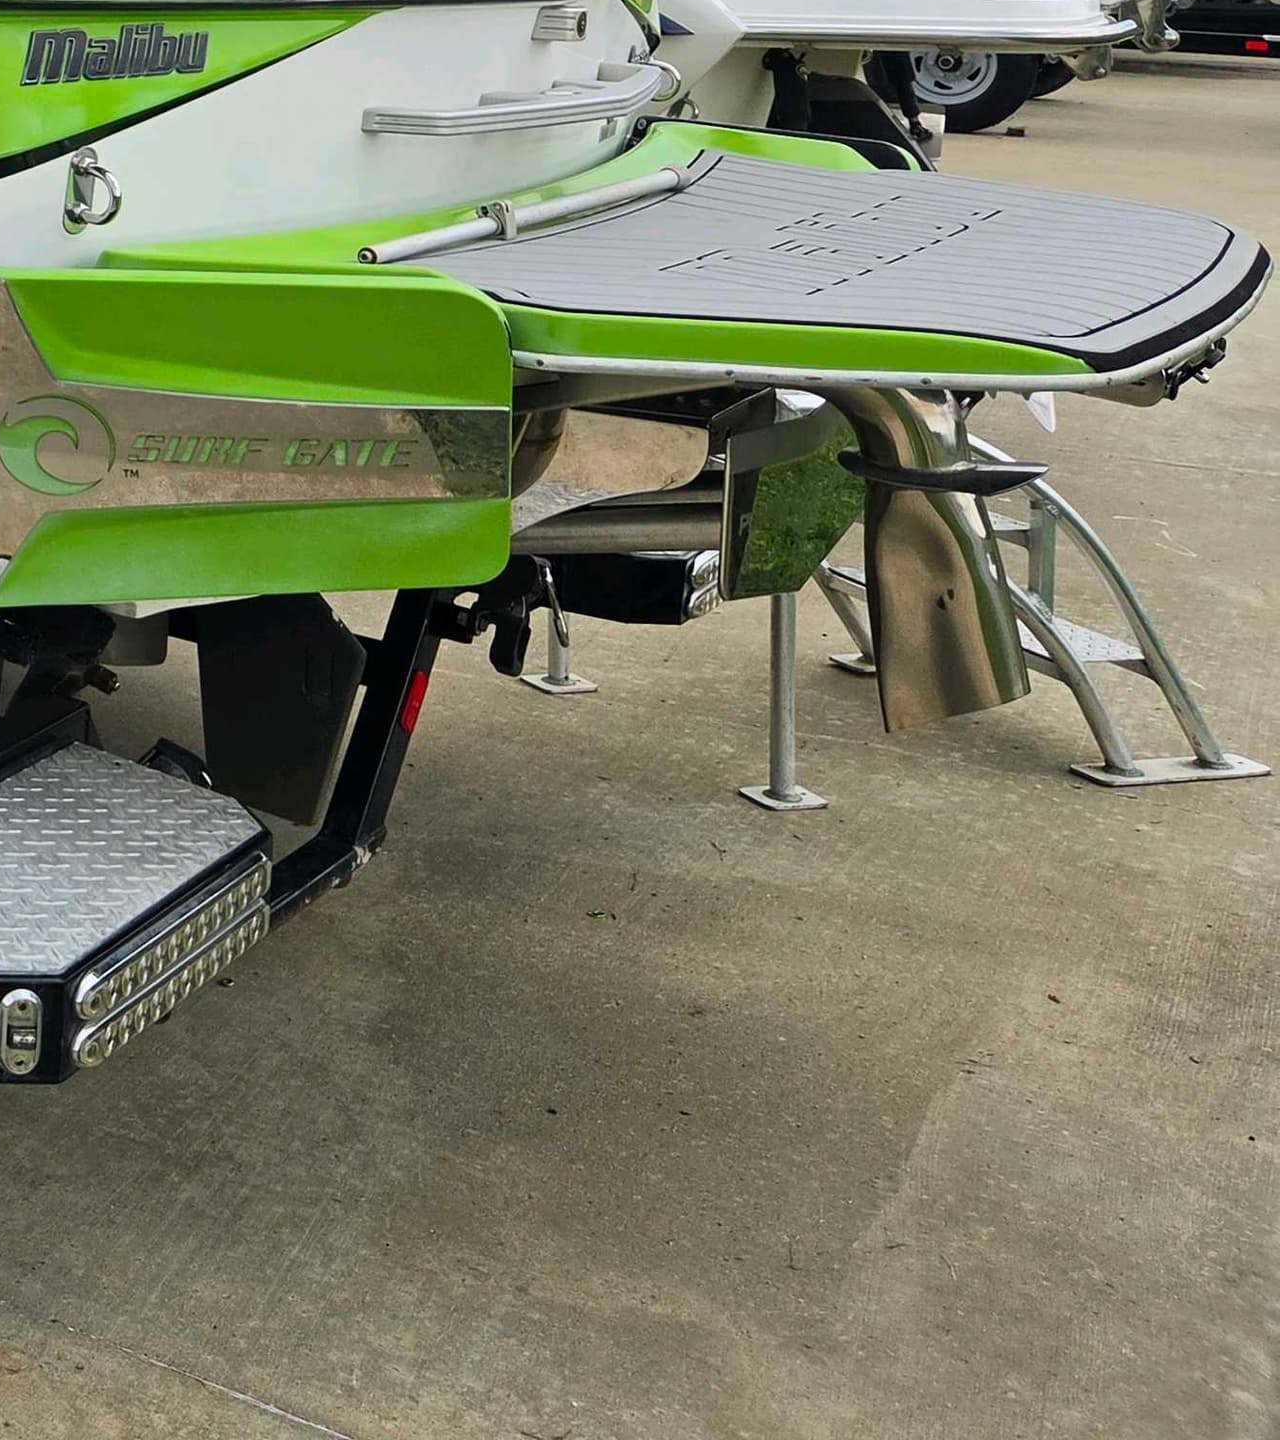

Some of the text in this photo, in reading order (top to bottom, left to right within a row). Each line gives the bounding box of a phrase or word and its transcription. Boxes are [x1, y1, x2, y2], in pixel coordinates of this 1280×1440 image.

[19, 22, 209, 87] Malibu
[127, 434, 419, 468] SURF GATE
